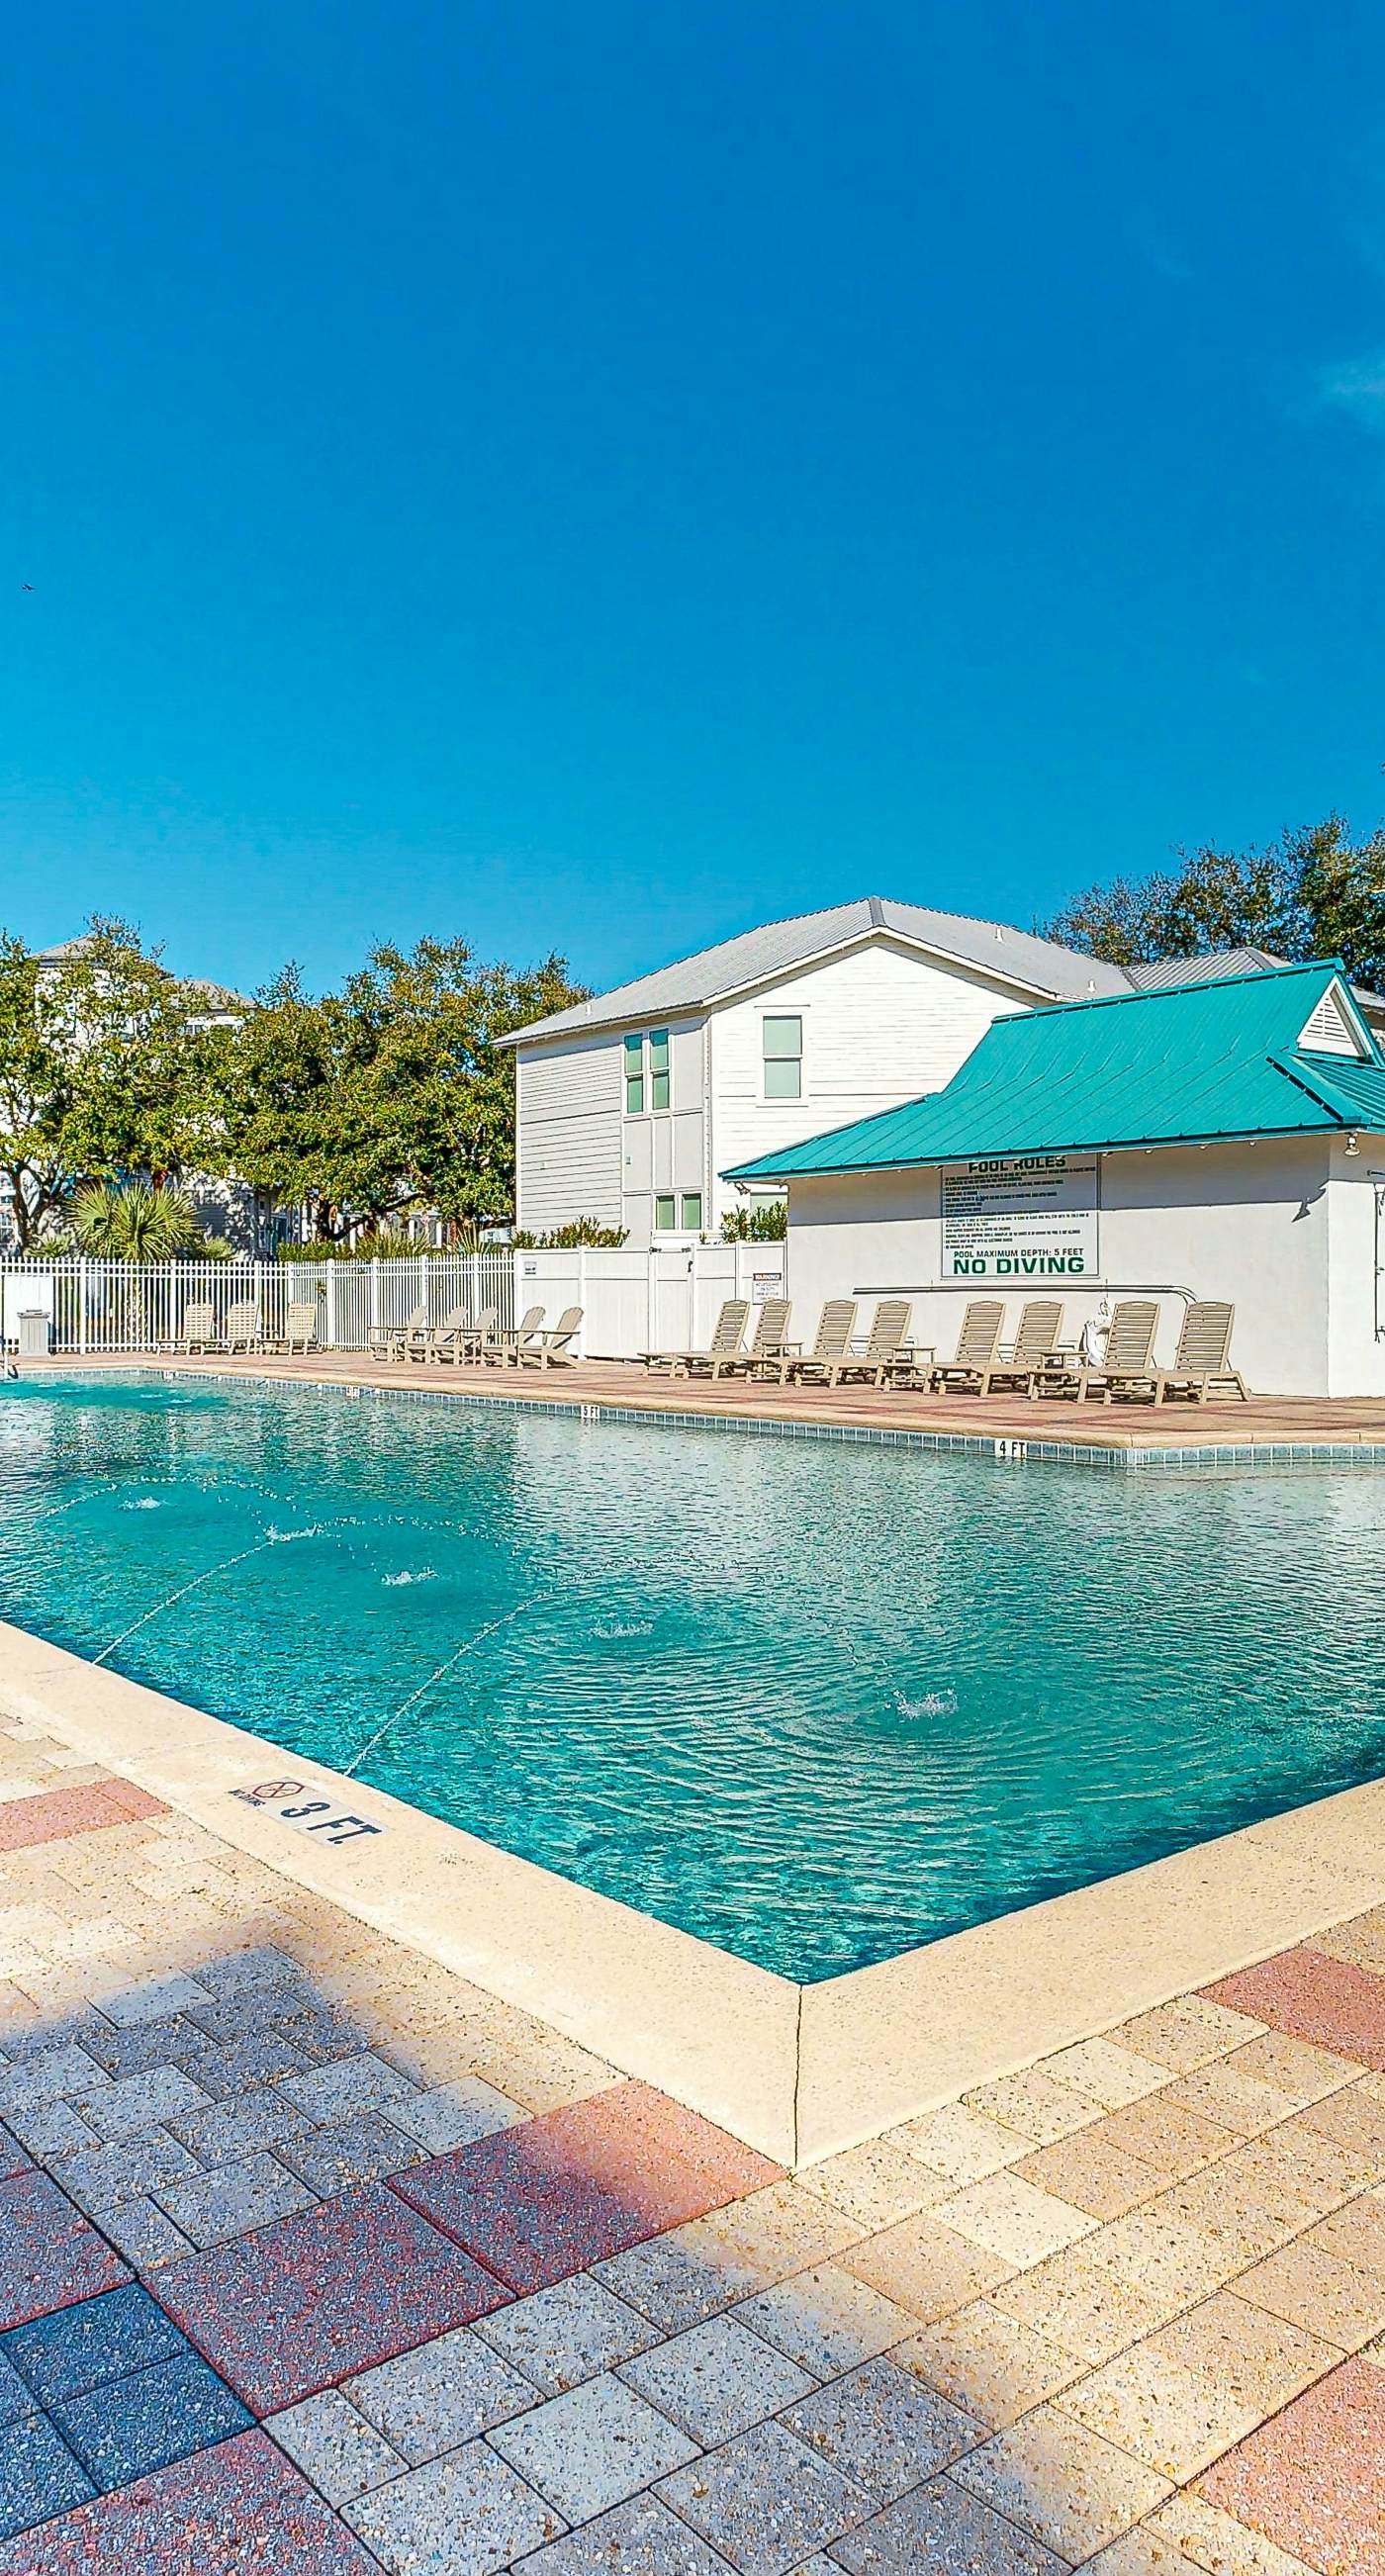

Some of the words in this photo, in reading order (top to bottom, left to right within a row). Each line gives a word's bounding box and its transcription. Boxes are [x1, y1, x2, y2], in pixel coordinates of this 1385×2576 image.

[1021, 1248, 1052, 1257] DEPTH:
[1062, 1247, 1084, 1256] FEET
[954, 1259, 986, 1275] NO
[996, 1257, 1084, 1274] DIVING
[583, 1406, 589, 1417] 5
[999, 1440, 1006, 1454] 4
[280, 1801, 331, 1818] 3
[307, 1816, 383, 1845] FT.
